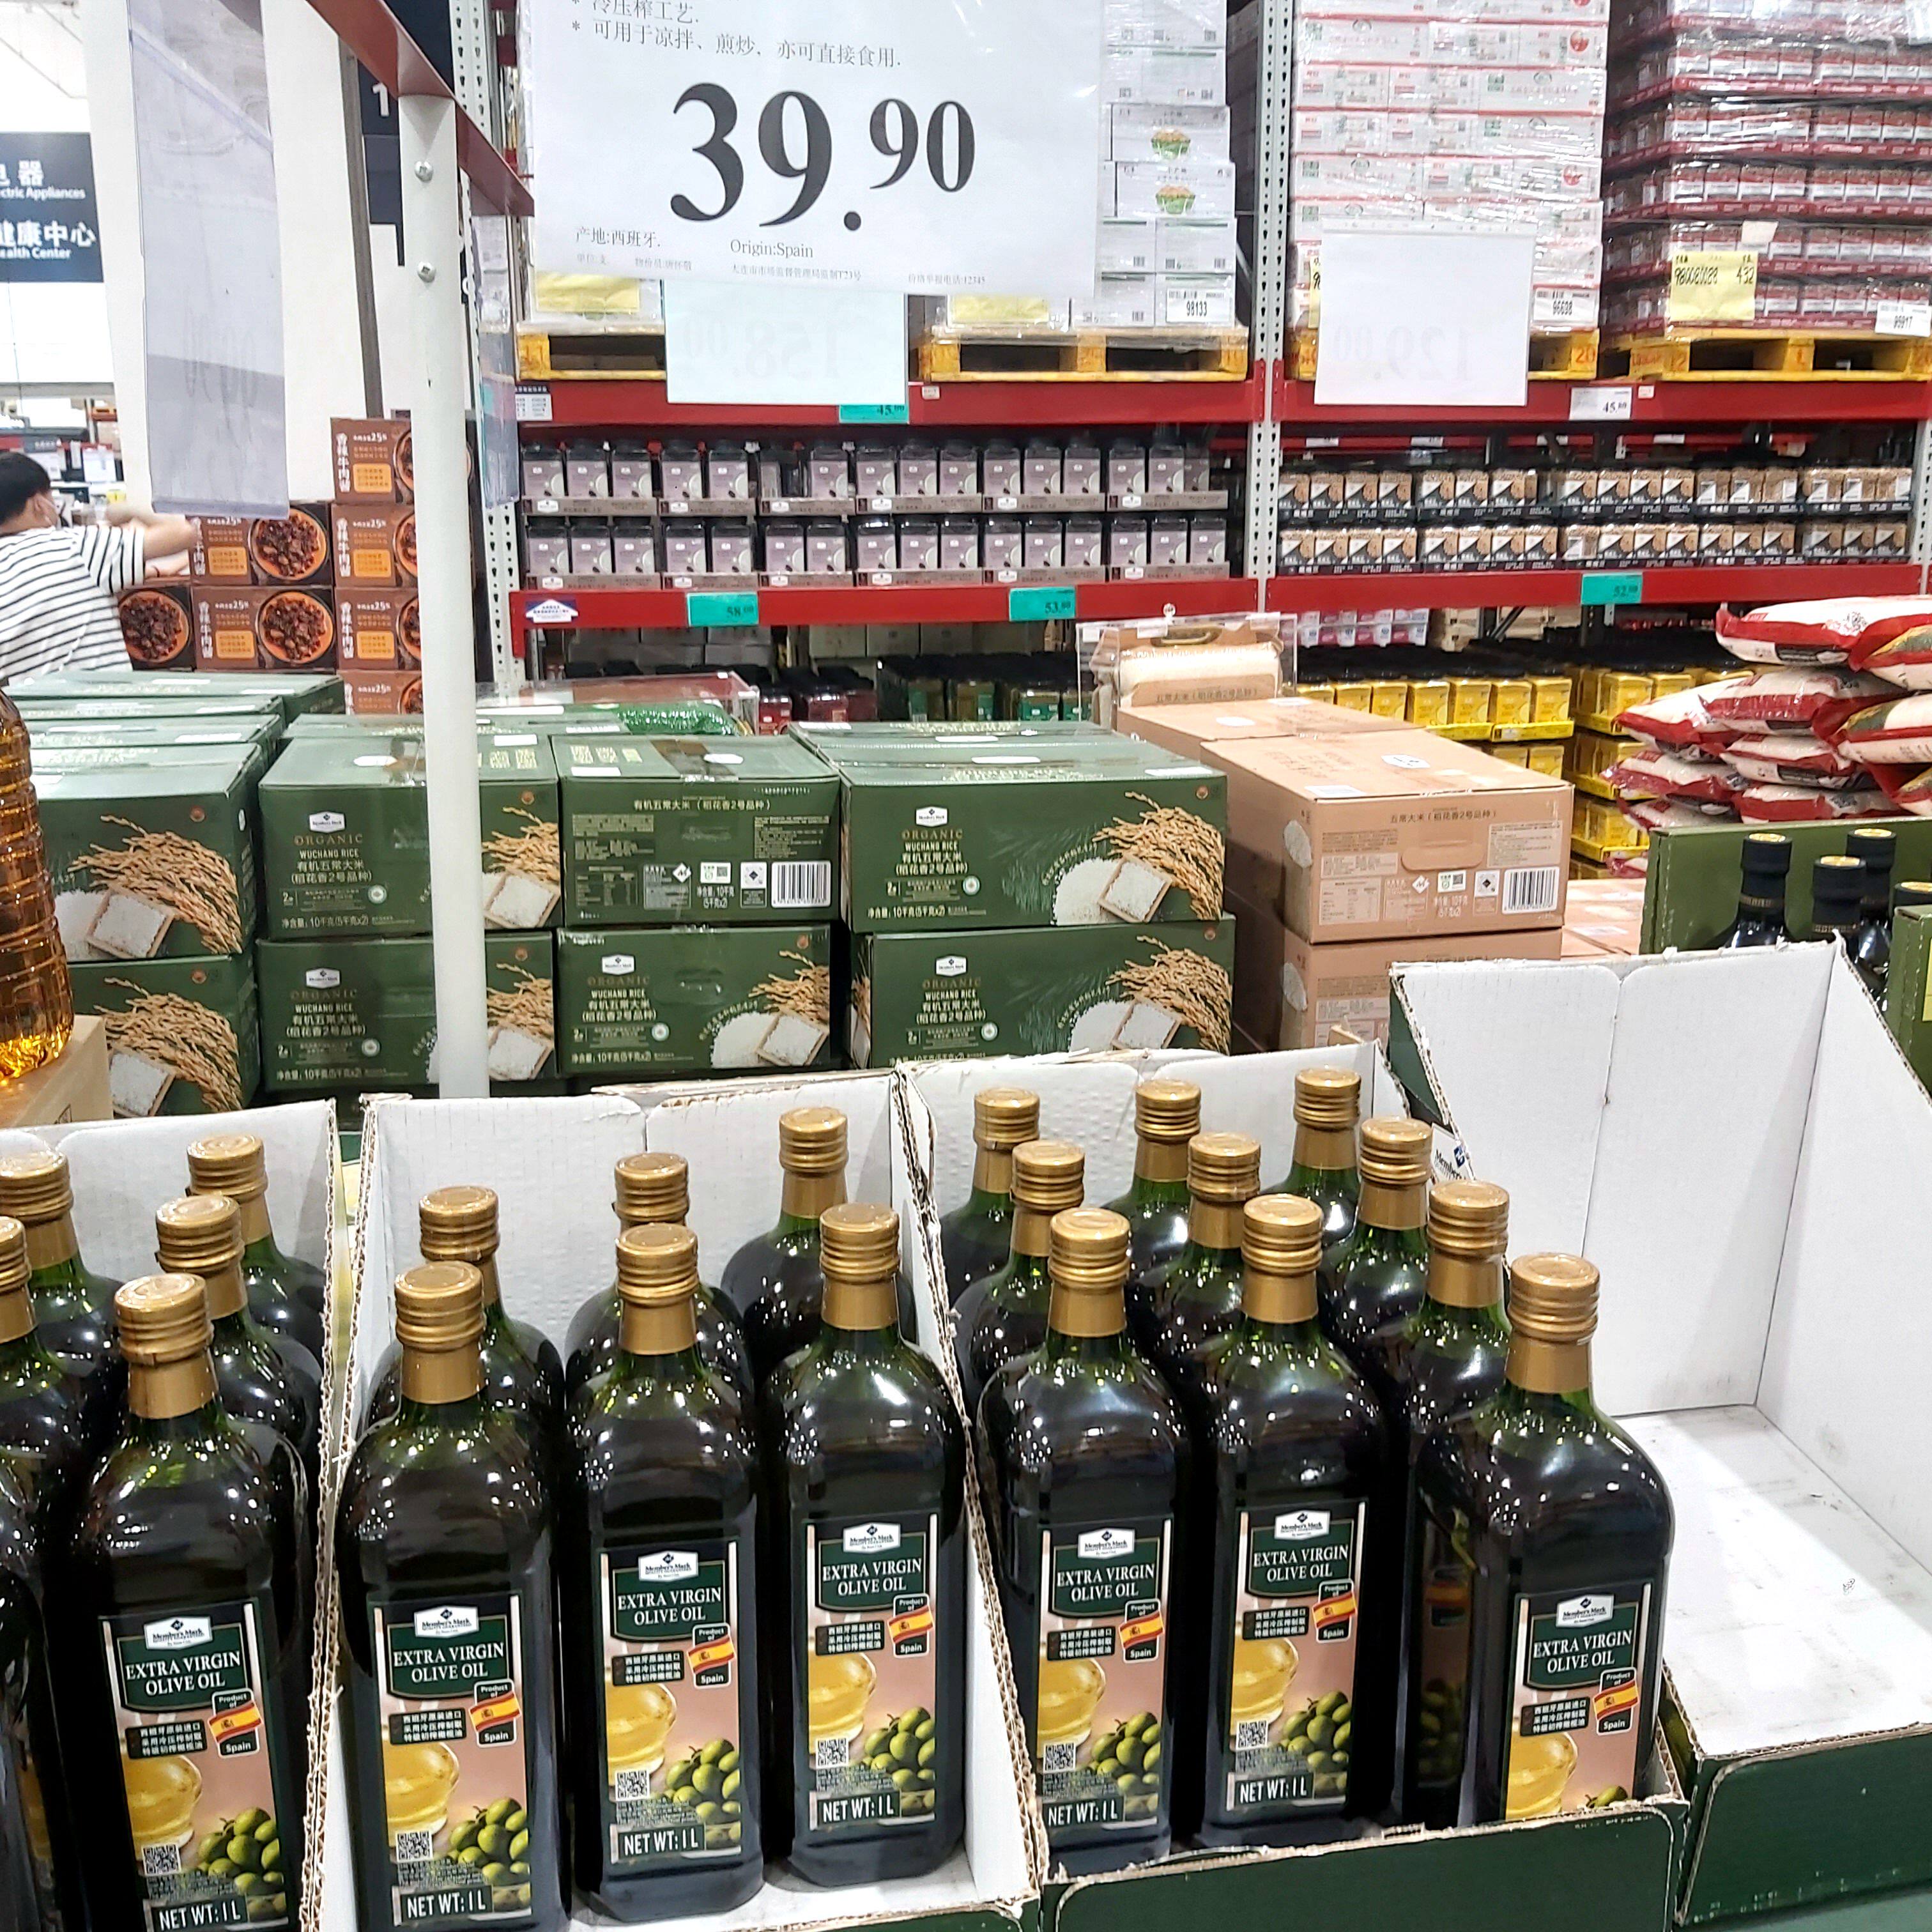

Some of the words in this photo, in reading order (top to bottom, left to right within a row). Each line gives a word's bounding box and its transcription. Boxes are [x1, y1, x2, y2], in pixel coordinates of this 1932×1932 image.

[670, 82, 976, 232] 39.90
[26, 186, 86, 201] Appliances
[32, 247, 72, 259] Center
[730, 239, 813, 258] Origin:Spain
[294, 834, 362, 845] ORGANIC
[901, 829, 963, 840] ORGANIC
[300, 849, 339, 859] WUCHANG
[342, 848, 358, 857] RICE
[905, 841, 940, 852] WUCHANG
[942, 841, 958, 850] RICE
[587, 976, 650, 986] ORGANIC
[922, 977, 981, 989] ORGANIC
[291, 990, 356, 999] ORGANIC
[591, 990, 627, 999] WUCHANG
[629, 988, 645, 998] RICE
[925, 991, 958, 1001] WUCHANG
[961, 990, 976, 999] RICE
[295, 1004, 334, 1013] WUCHANG
[336, 1003, 353, 1012] RICE
[1254, 1550, 1298, 1567] EXTRA
[1301, 1545, 1348, 1563] VIRGIN
[823, 1563, 870, 1582] EXTRA
[873, 1558, 921, 1576] VIRGIN
[1057, 1569, 1102, 1587] EXTRA
[1107, 1564, 1154, 1582] VIRGIN
[1267, 1565, 1307, 1583] OLIVE
[1310, 1563, 1333, 1578] OIL
[838, 1578, 879, 1596] OLIVE
[883, 1577, 907, 1591] OIL
[1071, 1584, 1112, 1602] OLIVE
[1116, 1583, 1138, 1597] OIL
[618, 1591, 666, 1610] EXTRA
[670, 1587, 721, 1606] VIRGIN
[634, 1608, 678, 1625] OLIVE
[682, 1606, 705, 1621] OIL
[1323, 1629, 1344, 1638] Spain
[900, 1643, 922, 1653] Spain
[1131, 1648, 1151, 1658] Spain
[1534, 1637, 1579, 1658] EXTRA
[1583, 1630, 1632, 1650] VIRGIN
[393, 1648, 447, 1667] EXTRA
[448, 1643, 503, 1662] VIRGIN
[1547, 1653, 1588, 1673] OLIVE
[1591, 1650, 1614, 1666] OIL
[126, 1660, 180, 1680] EXTRA
[183, 1650, 240, 1673] VIRGIN
[411, 1664, 458, 1683] OLIVE
[462, 1662, 488, 1678] OIL
[146, 1675, 194, 1696] OLIVE
[197, 1672, 225, 1689] OIL
[701, 1674, 723, 1684] Spain
[219, 1694, 247, 1703] Product
[1603, 1719, 1625, 1729] Spain
[484, 1731, 509, 1744] Spain
[226, 1741, 251, 1754] Spain
[1241, 1781, 1264, 1804] NET
[1268, 1778, 1289, 1799] WT:
[1300, 1776, 1307, 1796] L
[823, 1800, 848, 1823] NET
[852, 1797, 875, 1819] WT:
[887, 1795, 894, 1814] L
[1048, 1804, 1073, 1826] NET
[1077, 1802, 1099, 1823] WT:
[1110, 1799, 1117, 1819] L
[624, 1833, 650, 1856] NET
[654, 1830, 678, 1851] WT:
[691, 1828, 698, 1848] L
[408, 1895, 434, 1918] NET
[438, 1891, 464, 1913] WT:
[478, 1890, 486, 1910] L
[159, 1908, 187, 1931] NET
[192, 1904, 219, 1926] WT:
[231, 1900, 241, 1920] L
